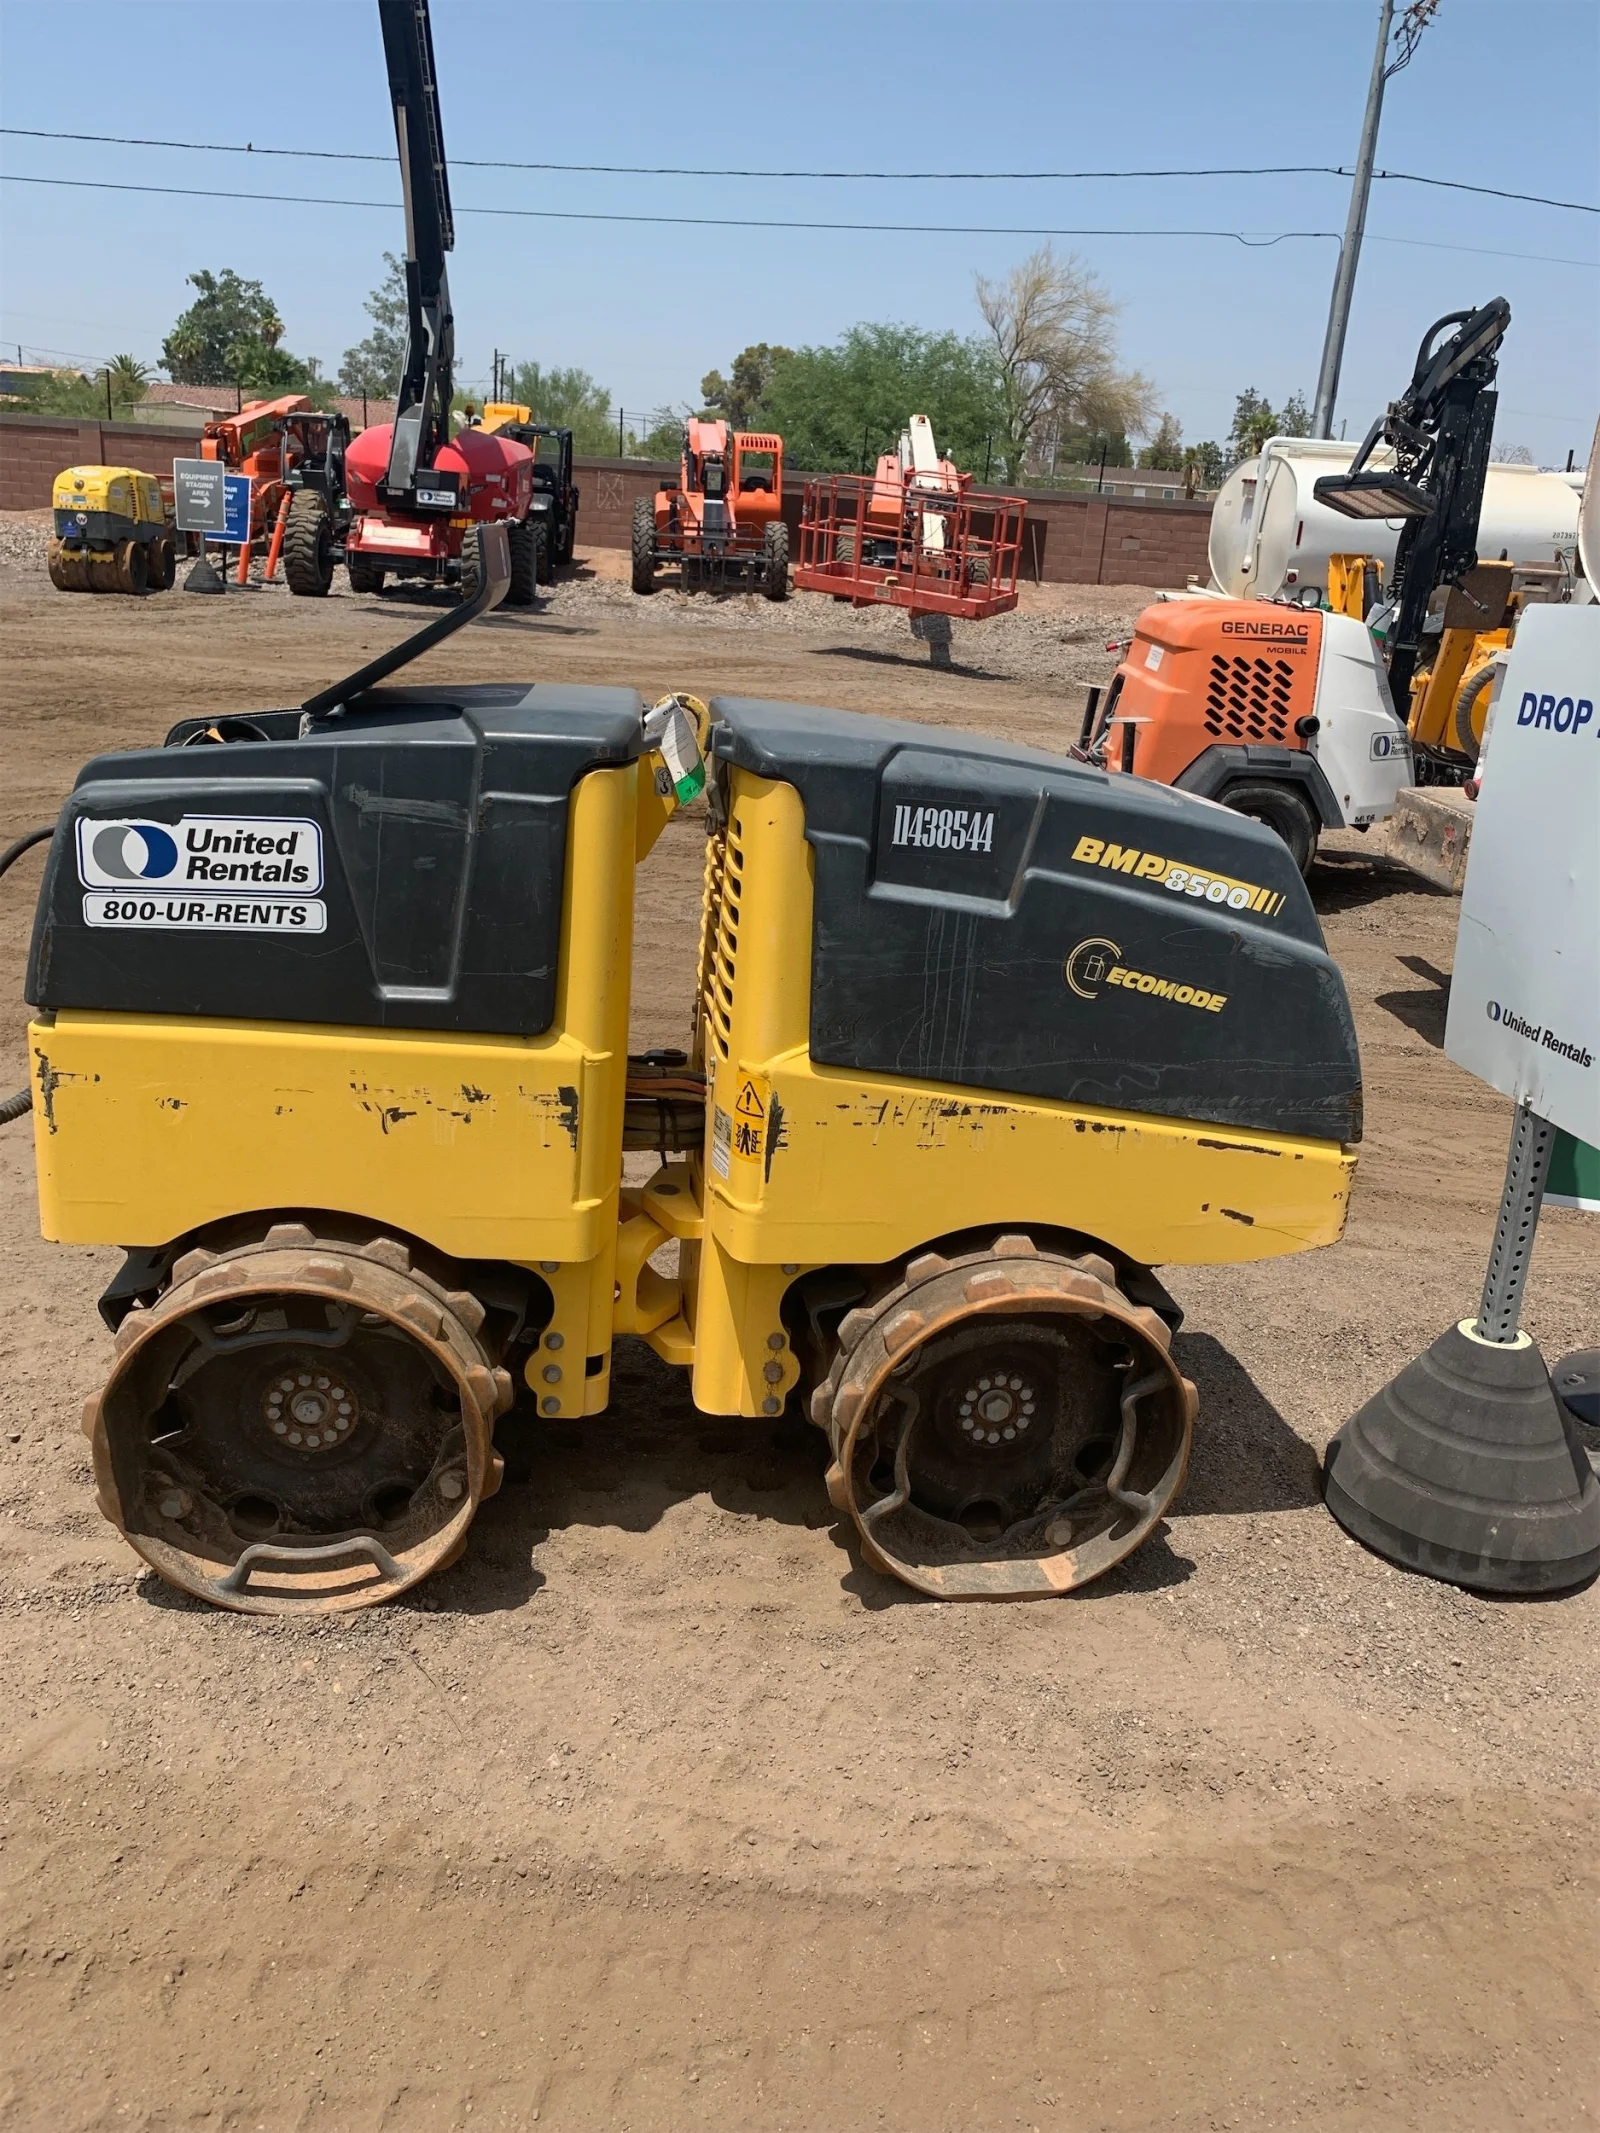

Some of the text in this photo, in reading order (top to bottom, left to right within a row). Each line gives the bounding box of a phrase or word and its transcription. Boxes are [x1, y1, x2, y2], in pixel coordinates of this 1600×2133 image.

[180, 472, 219, 482] EQUIPMENT
[185, 481, 214, 490] STAGING
[1221, 622, 1309, 636] GENERAC
[1266, 647, 1307, 655] MOBILE
[1517, 692, 1594, 735] DROP
[186, 828, 299, 855] United
[892, 805, 994, 852] 11438544
[186, 856, 309, 883] Rentals
[103, 901, 307, 926] 800-UR-RENTS
[1105, 966, 1228, 1013] ECOMODE
[1502, 1008, 1593, 1068] United Rentals
